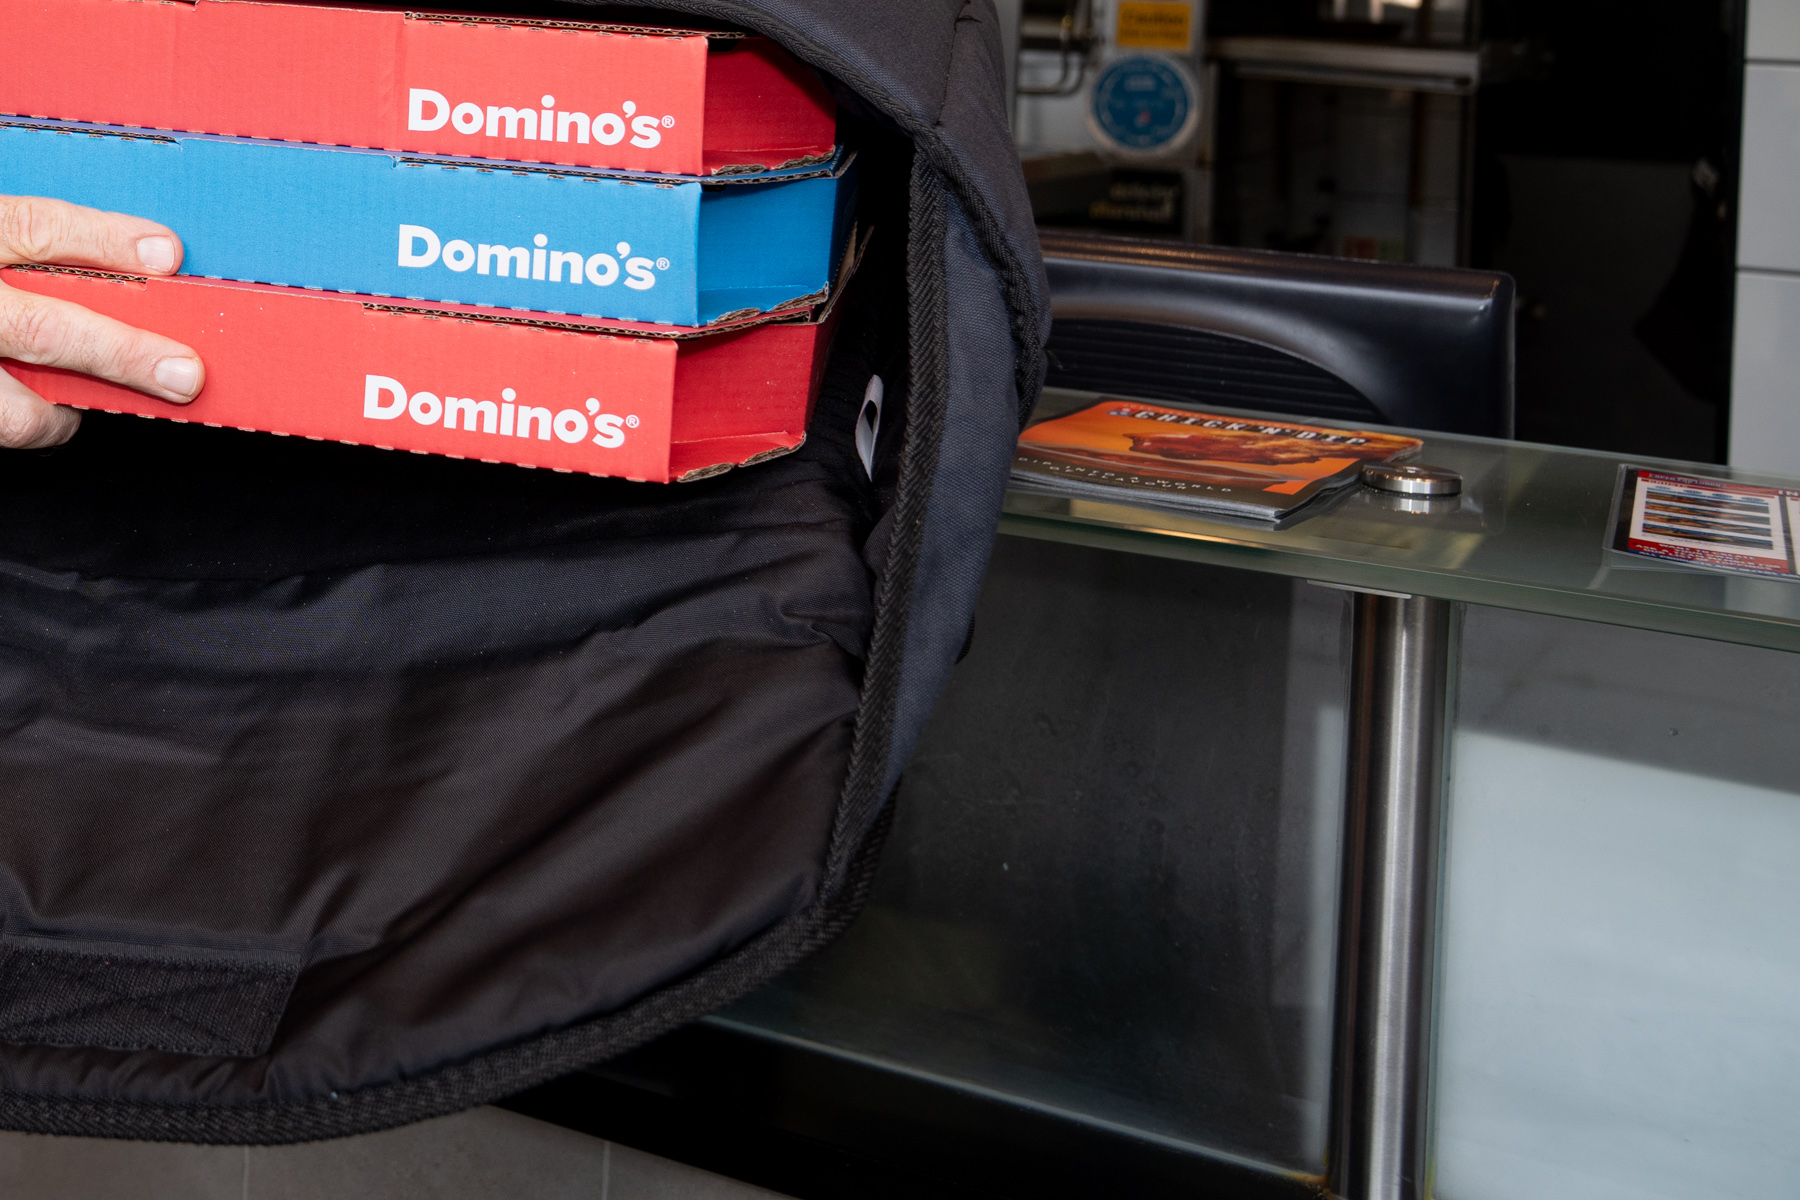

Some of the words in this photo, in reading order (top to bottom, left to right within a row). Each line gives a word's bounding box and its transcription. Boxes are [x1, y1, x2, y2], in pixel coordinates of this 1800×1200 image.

[1134, 410, 1246, 431] CHICK
[1296, 431, 1367, 444] DIP
[1065, 465, 1115, 477] INTO
[1156, 479, 1232, 492] WORLD
[1087, 473, 1187, 490] FLAVOUR
